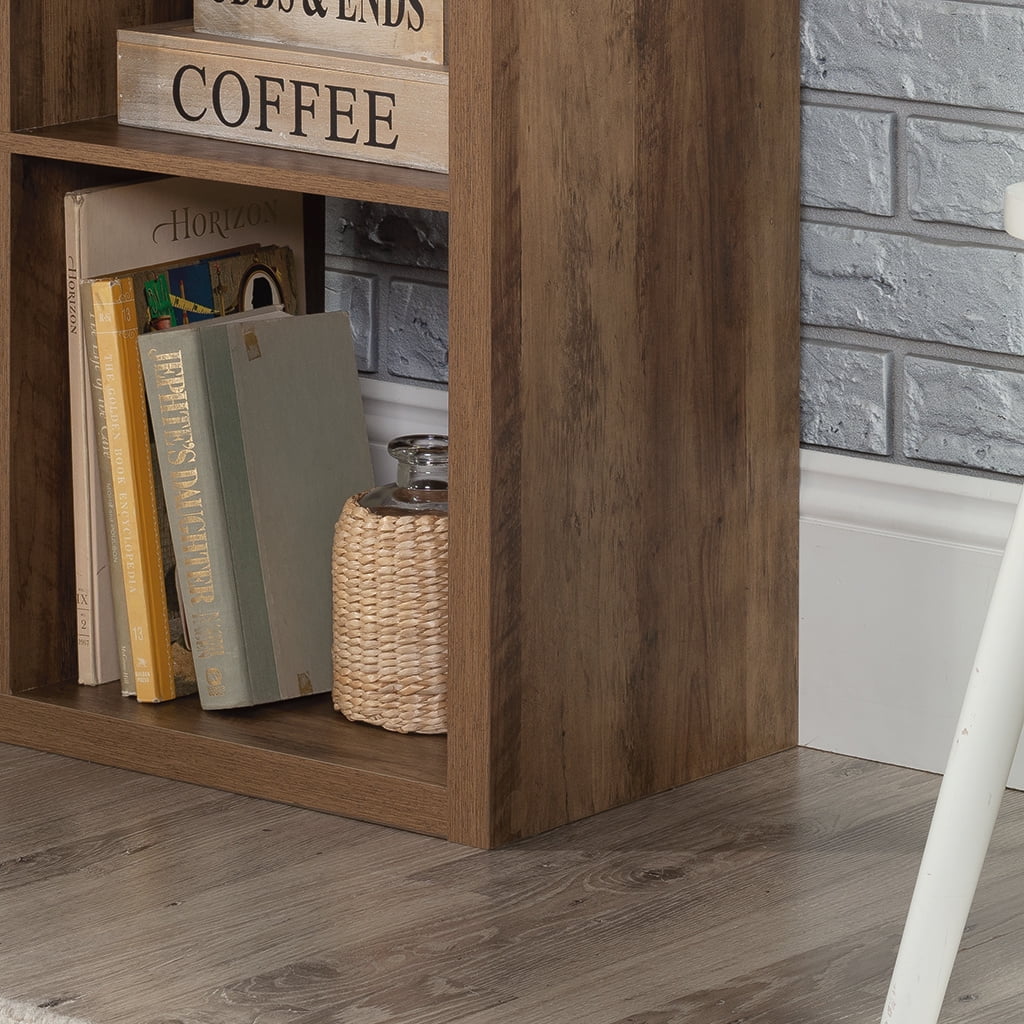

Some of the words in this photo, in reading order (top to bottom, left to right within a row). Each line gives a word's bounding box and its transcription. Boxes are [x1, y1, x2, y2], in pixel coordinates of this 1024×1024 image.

[172, 64, 399, 150] COFFEE
[152, 200, 278, 245] HORIZON
[67, 255, 78, 335] HORIZON
[121, 307, 132, 322] 13
[104, 354, 116, 381] THE
[107, 387, 122, 441] GOLDEN
[114, 448, 126, 485] BOOK
[119, 492, 137, 593] ENCYCLOPEDIA
[170, 467, 216, 607] DAUGHTER
[76, 593, 88, 605] IX
[80, 619, 87, 630] 2
[132, 625, 144, 641] 13
